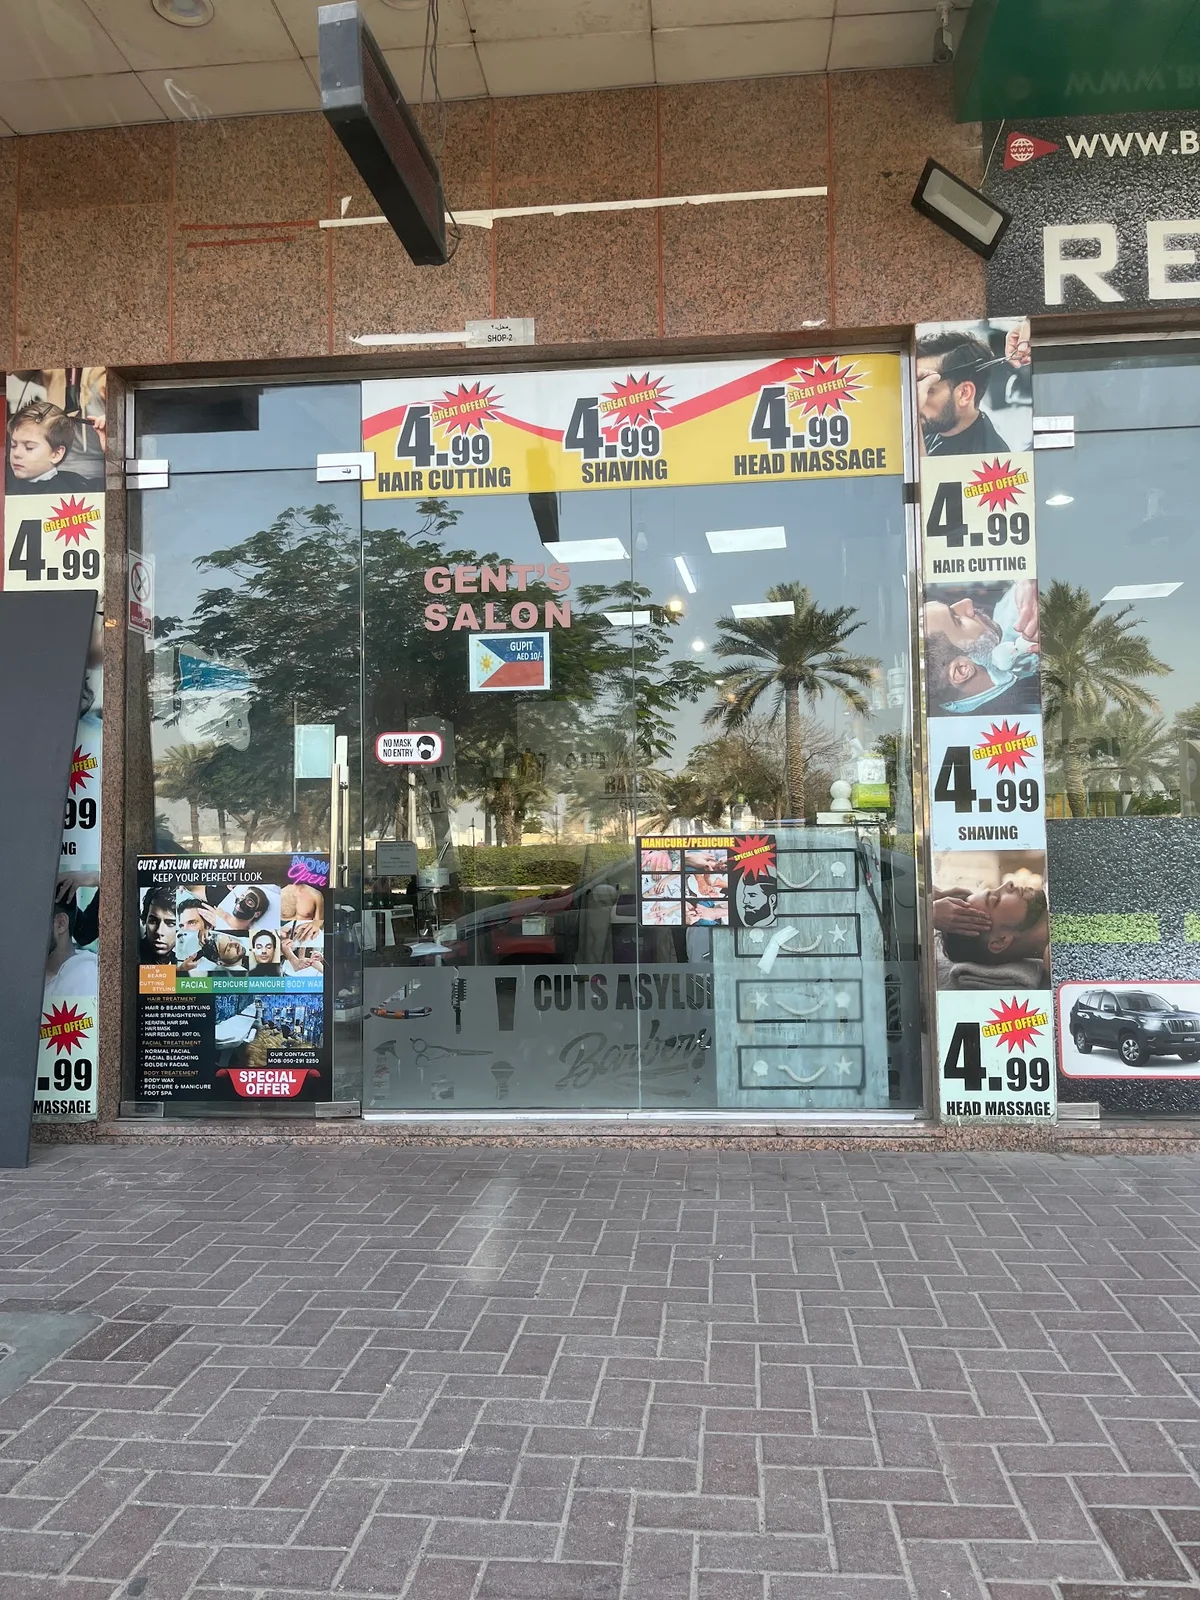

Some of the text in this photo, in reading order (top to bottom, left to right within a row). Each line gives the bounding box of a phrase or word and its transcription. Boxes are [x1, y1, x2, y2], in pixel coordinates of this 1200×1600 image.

[488, 334, 513, 342] SHOP-2
[600, 389, 658, 412] GREAT OFFER!
[788, 378, 847, 402] GREAT OFFER!
[432, 398, 489, 422] GREAT OFFER!
[751, 386, 849, 450] 4.99
[397, 406, 490, 468] 4.99
[565, 397, 660, 459] 4.99
[582, 459, 668, 483] SHAVING
[734, 448, 886, 475] HEAD MASSAGE
[378, 467, 511, 492] HAIR CUTTING
[964, 472, 1029, 498] GREAT OFFER!
[44, 509, 101, 532] GREAT OFFER!
[927, 482, 1030, 547] 4.99
[9, 519, 100, 581] 4.99
[933, 556, 1026, 573] HAIR CUTTING
[424, 563, 571, 594] GENT'S
[424, 601, 571, 632] SALON
[510, 641, 534, 651] GUPIT
[531, 652, 543, 661] 10/-
[383, 739, 412, 747] NO MASK
[383, 749, 414, 757] NO ENTRY
[972, 735, 1038, 760] GREAT OFFER!
[934, 746, 1040, 813] 4.99
[642, 838, 735, 848] MANICURE/PEDICURE
[958, 826, 1018, 840] SHAVING
[138, 859, 246, 870] CUTS ASYLUM GENTS SALON
[291, 855, 330, 874] NOW
[734, 851, 754, 861] SPECIAL
[153, 872, 263, 882] KEEP YOUR PERFECT LOOK
[287, 980, 306, 988] BODY
[534, 974, 608, 1011] CUTS
[40, 1017, 93, 1039] REAT OFFER!
[982, 1012, 1048, 1037] GREAT OFFER!
[944, 1023, 1050, 1092] 4.99
[38, 1059, 92, 1091] .99
[240, 1071, 297, 1082] SPECIAL
[246, 1084, 290, 1095] OFFER
[34, 1100, 91, 1114] MASSAGE
[947, 1102, 1050, 1115] HEAD MASSAGE
